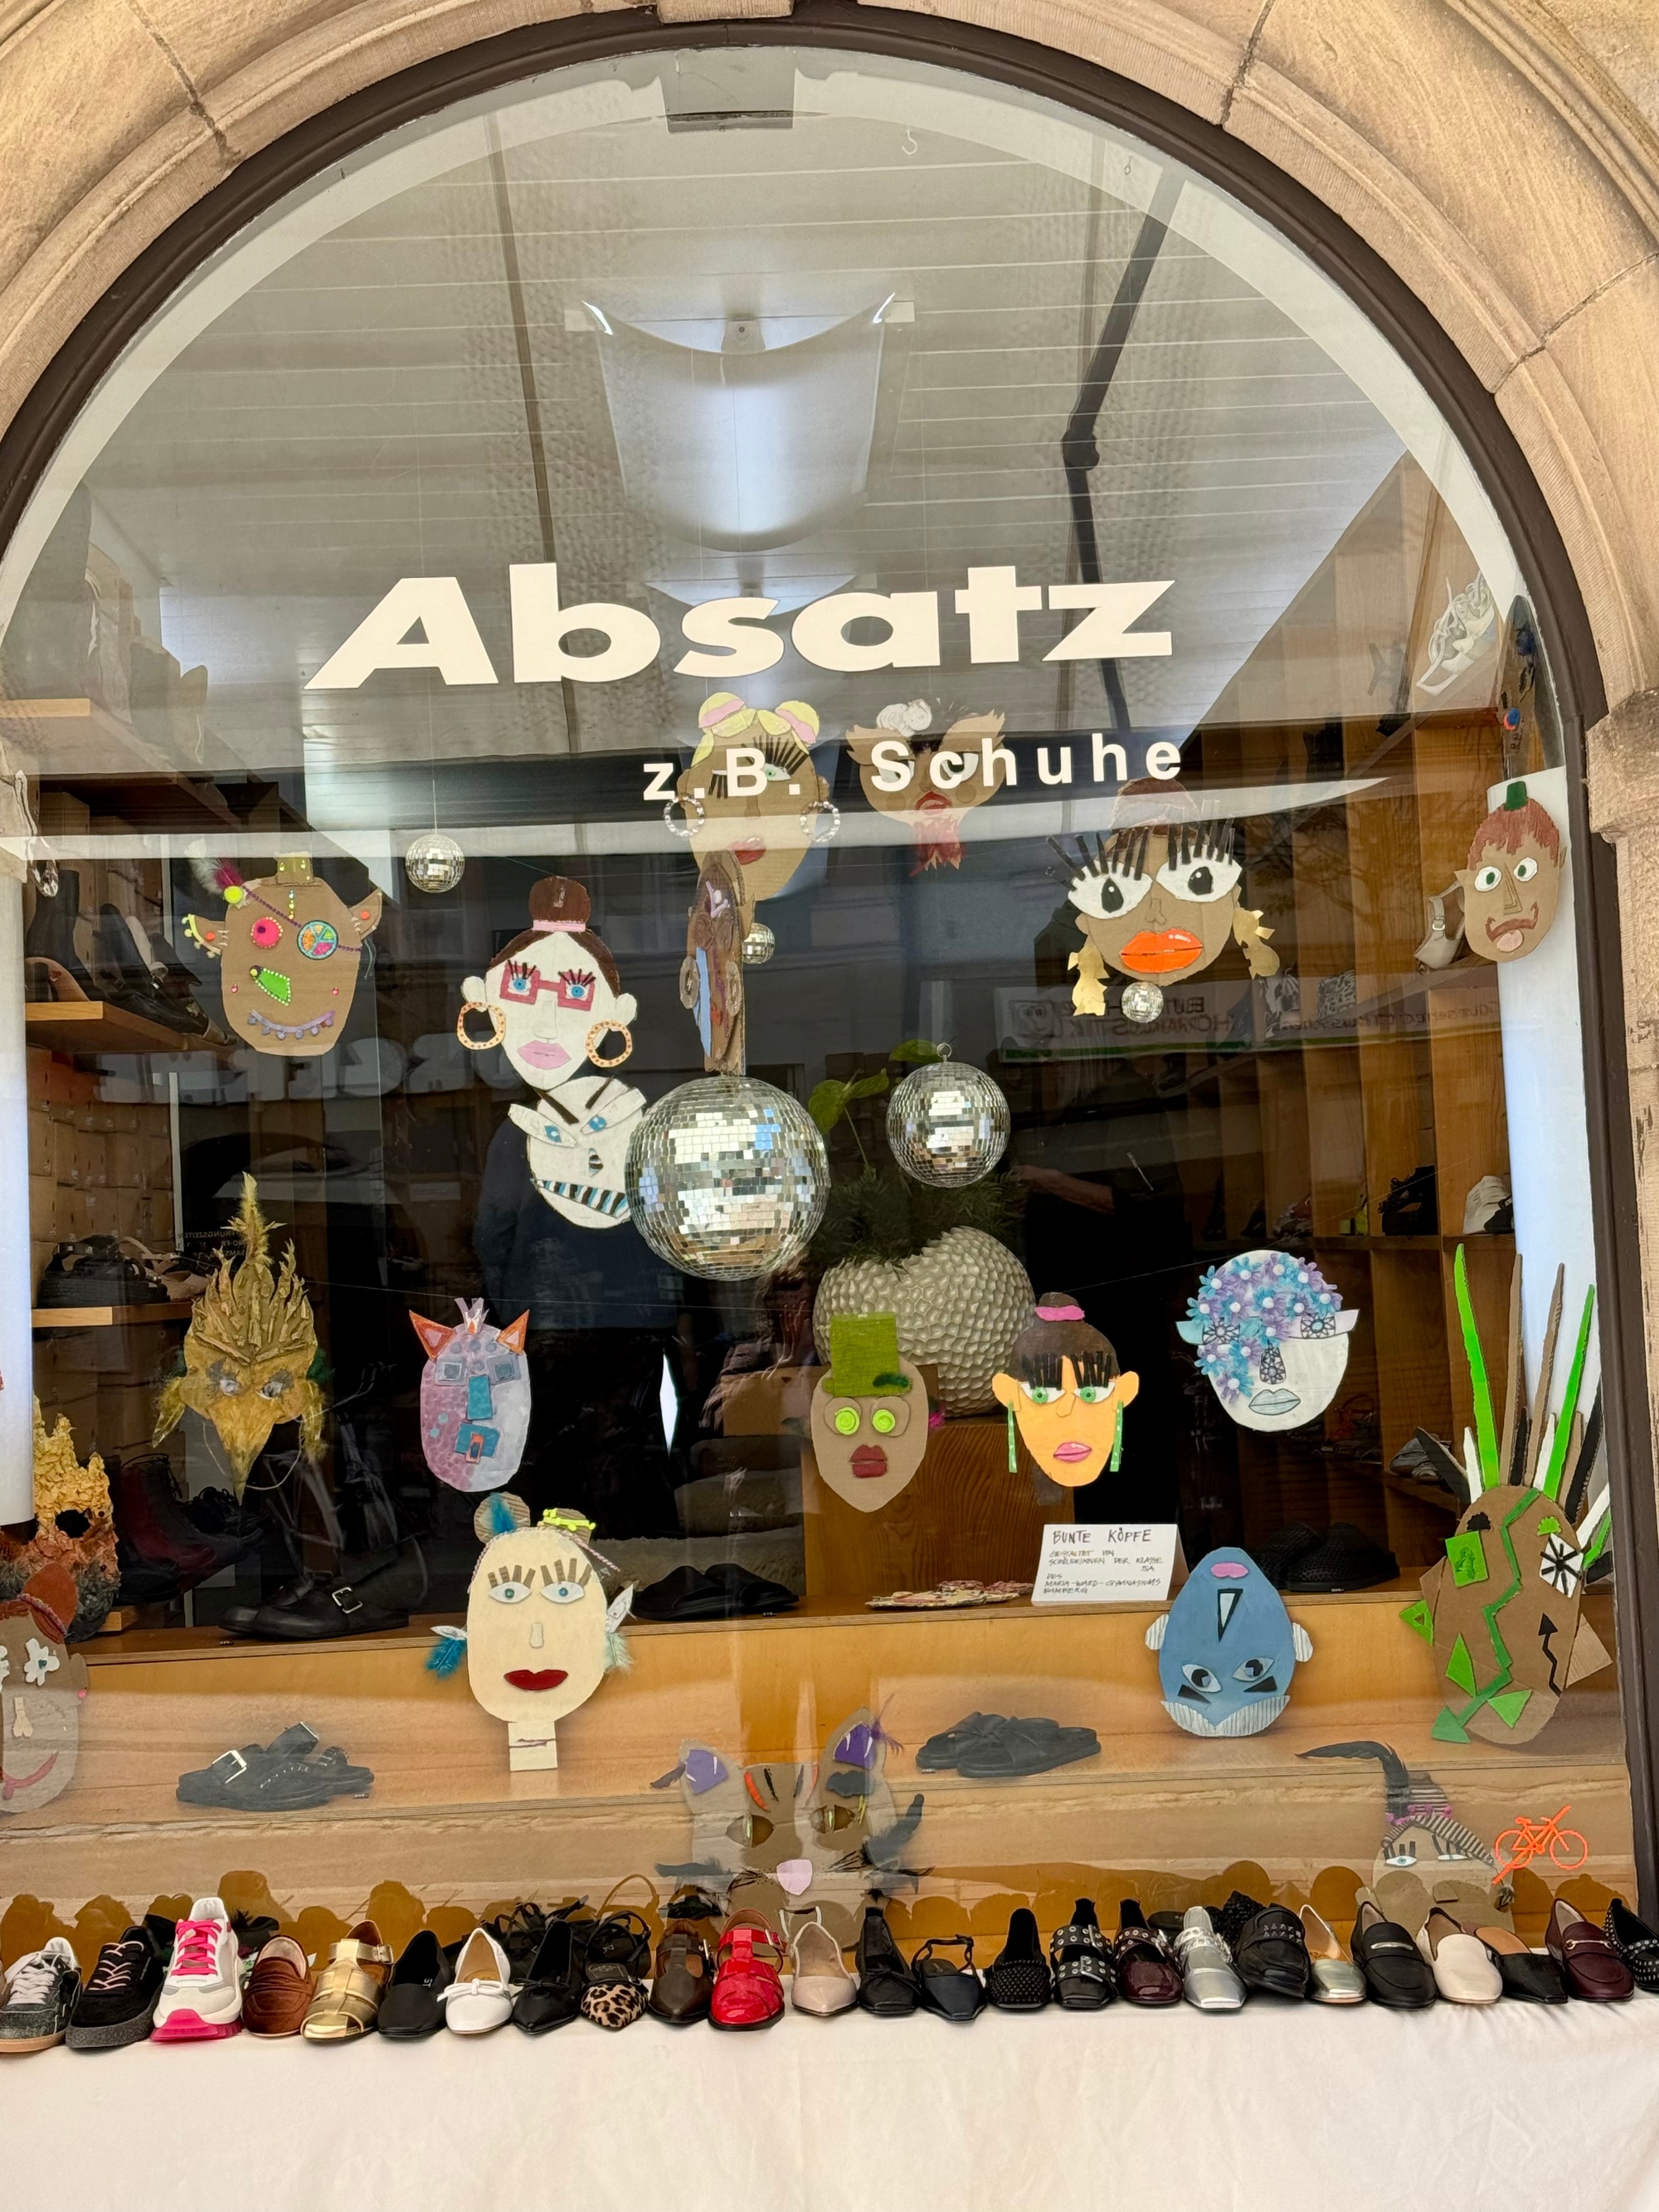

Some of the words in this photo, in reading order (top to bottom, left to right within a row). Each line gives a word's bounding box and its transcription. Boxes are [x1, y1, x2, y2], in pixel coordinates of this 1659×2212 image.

[304, 563, 1175, 689] Absatz
[871, 733, 1181, 791] Schuhe
[1053, 1529, 1091, 1544] BUNTE
[1107, 1527, 1151, 1544] KÖPFE
[1136, 1556, 1164, 1564] KLASSE
